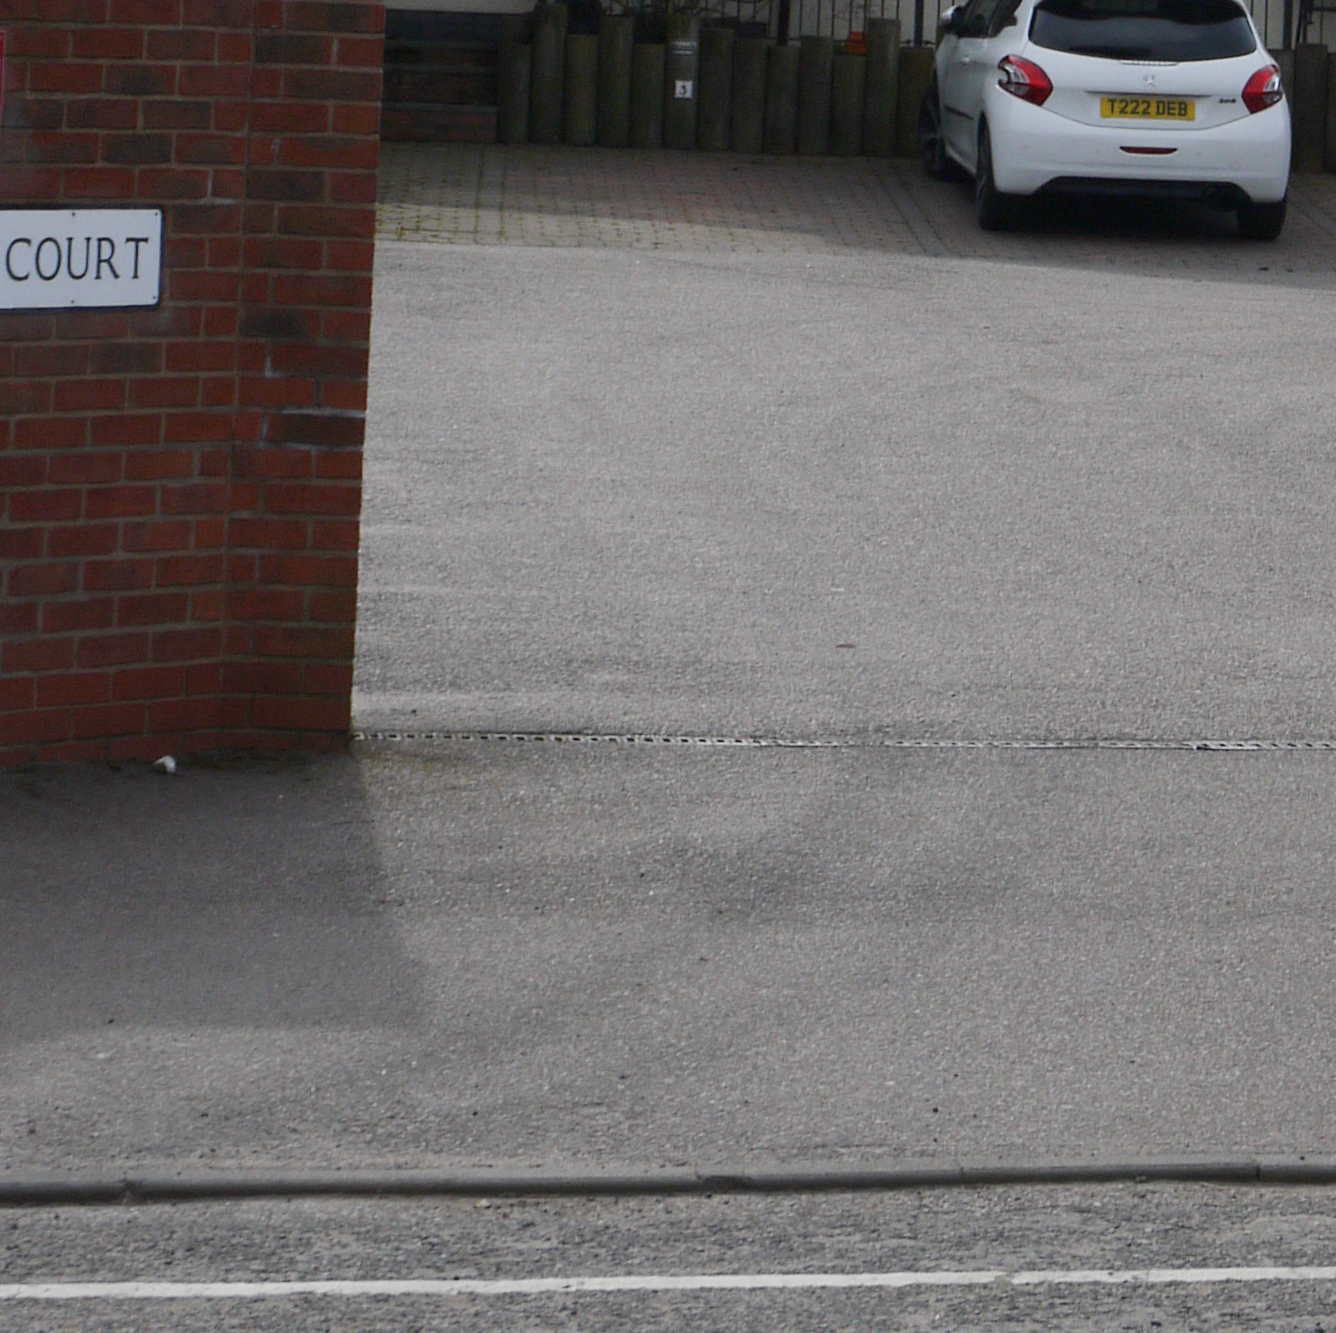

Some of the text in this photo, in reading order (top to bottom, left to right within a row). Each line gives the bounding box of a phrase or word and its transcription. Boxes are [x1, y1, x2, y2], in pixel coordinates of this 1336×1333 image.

[1107, 98, 1188, 117] T222 DEB
[6, 237, 149, 281] COURT
